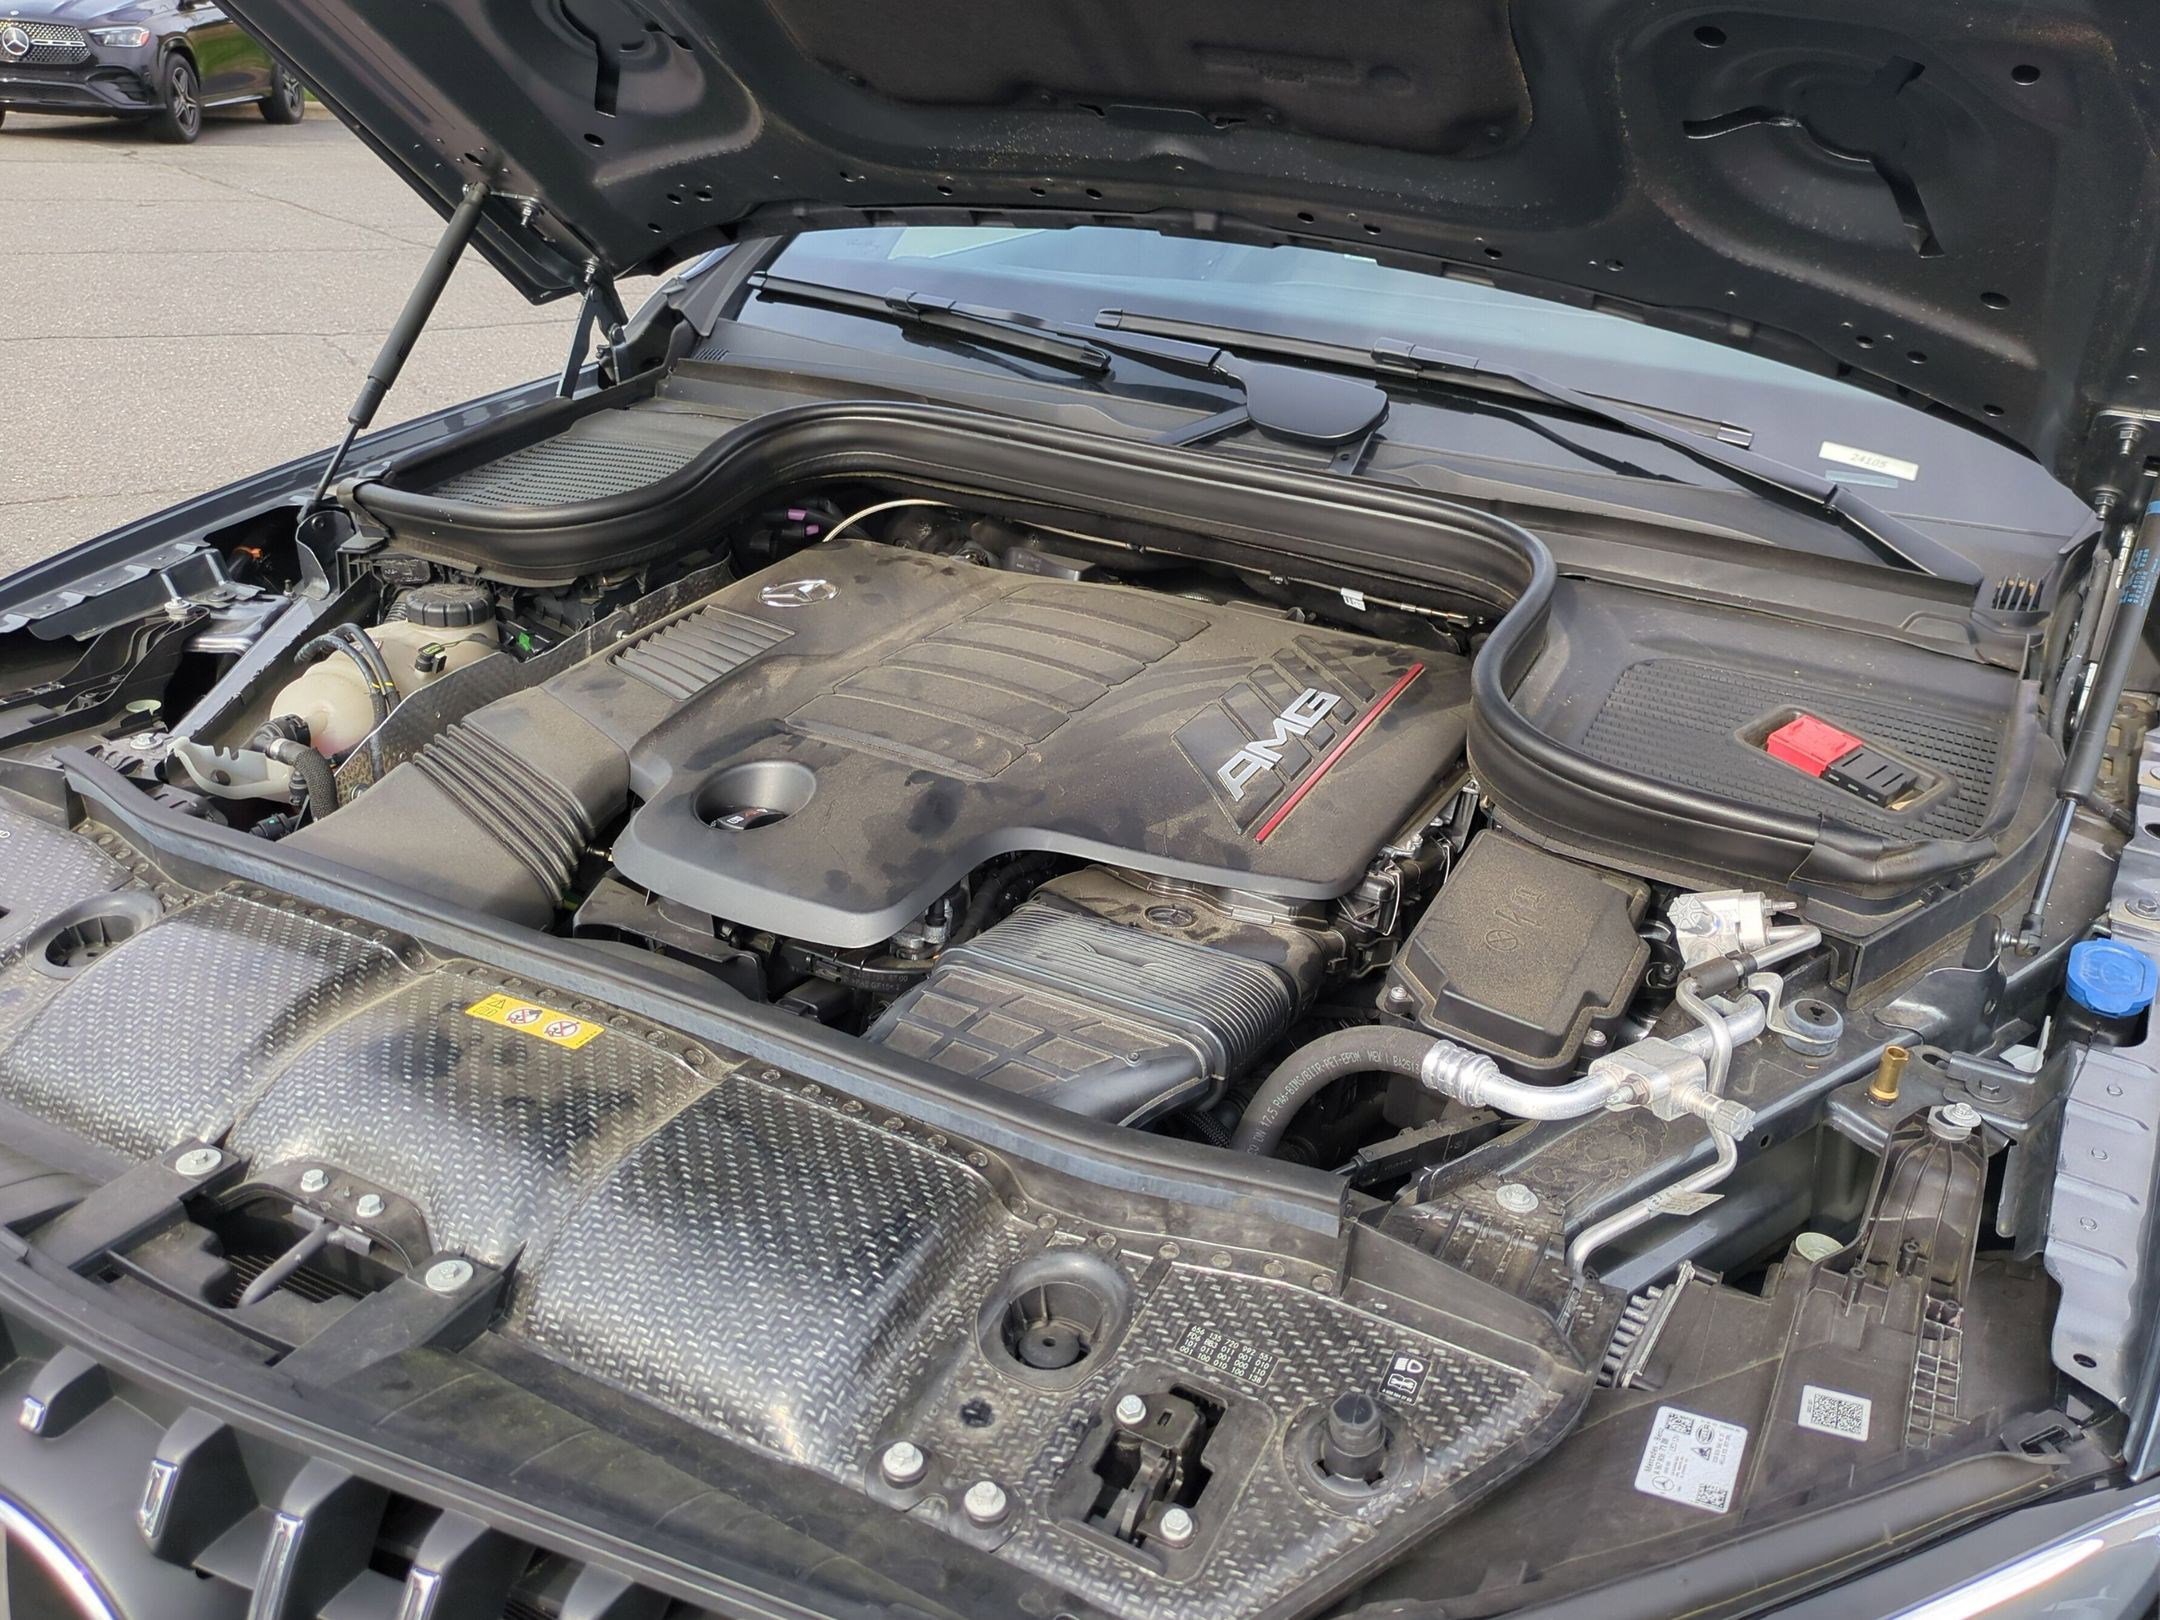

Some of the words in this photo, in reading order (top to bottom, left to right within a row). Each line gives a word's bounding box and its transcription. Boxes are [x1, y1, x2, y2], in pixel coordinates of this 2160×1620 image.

[1217, 687, 1341, 802] AMG
[1179, 1345, 1194, 1356] 001
[1197, 1352, 1211, 1363] 100
[1213, 1359, 1228, 1370] 010
[1231, 1366, 1245, 1377] 100
[1184, 1338, 1198, 1349] 101
[1200, 1345, 1214, 1356] 011
[1217, 1352, 1231, 1363] 001
[1234, 1359, 1249, 1370] 000
[1252, 1366, 1266, 1377] 110
[1187, 1331, 1202, 1342] FD6
[1221, 1345, 1235, 1356] 011
[1238, 1352, 1252, 1363] 001
[1255, 1359, 1270, 1370] 010
[1191, 1325, 1206, 1336] 656
[1209, 1332, 1222, 1343] 135
[1224, 1338, 1240, 1349] 720
[1242, 1345, 1257, 1356] 992
[1258, 1352, 1273, 1363] 551
